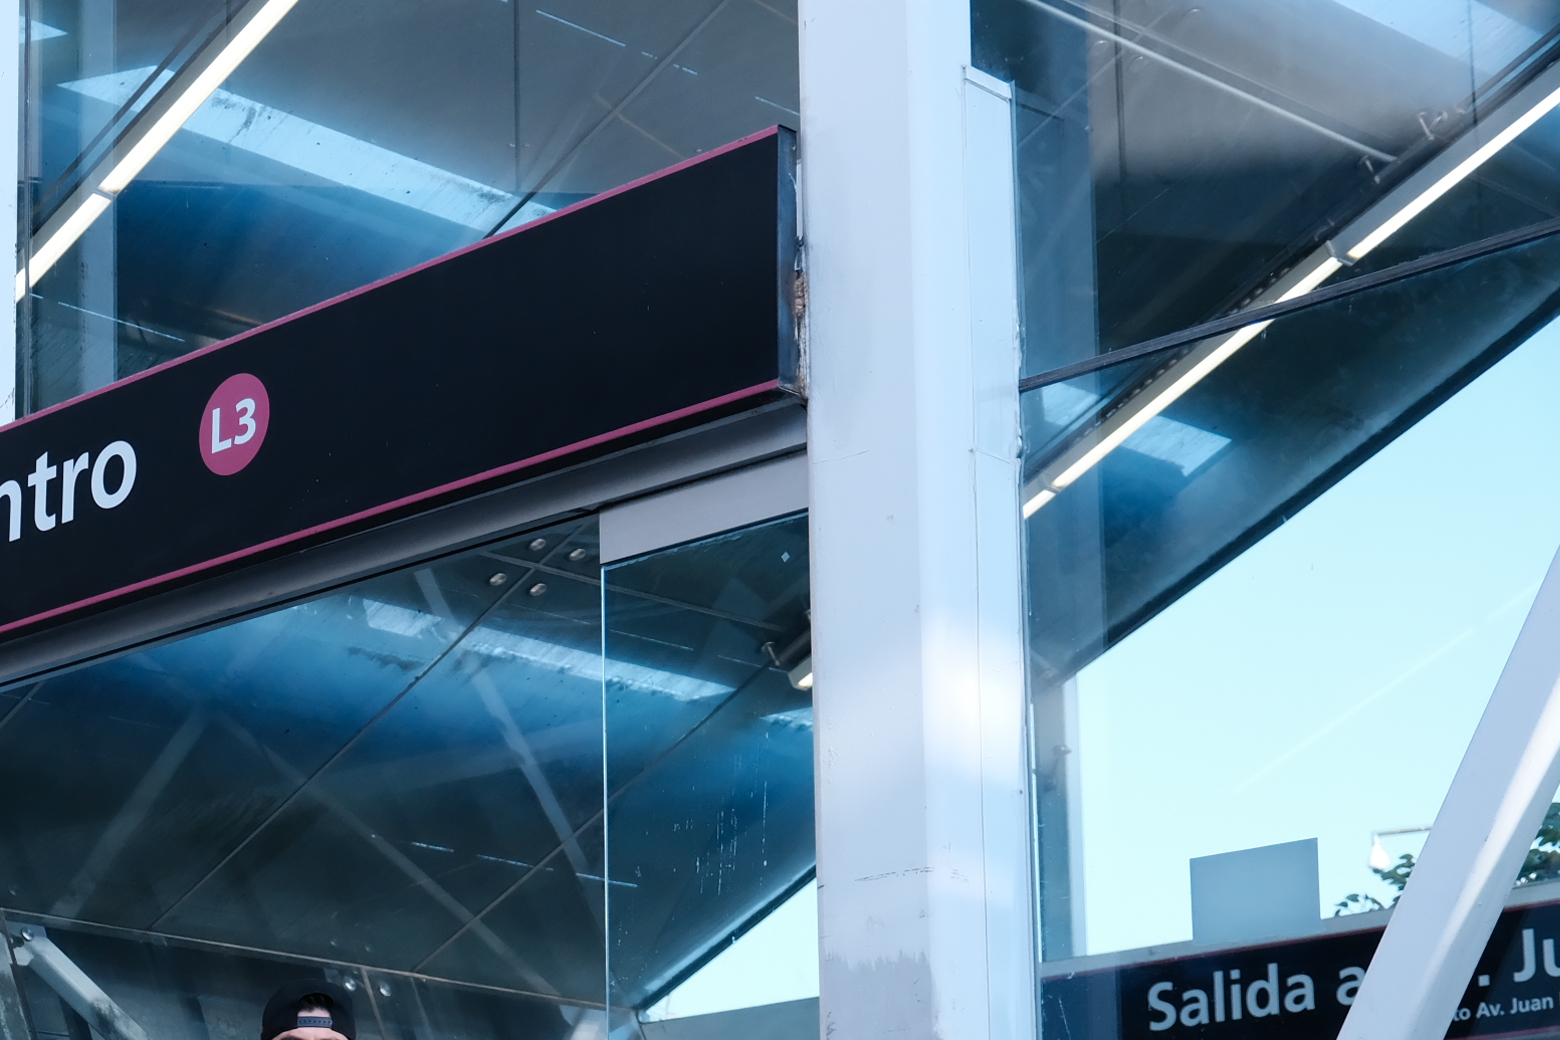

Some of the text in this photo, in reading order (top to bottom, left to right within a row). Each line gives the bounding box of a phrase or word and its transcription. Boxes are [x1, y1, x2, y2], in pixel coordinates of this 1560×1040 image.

[211, 397, 256, 454] L3
[1148, 962, 1316, 1032] Salida
[1475, 1001, 1505, 1019] Av.
[1509, 996, 1554, 1015] Juan
